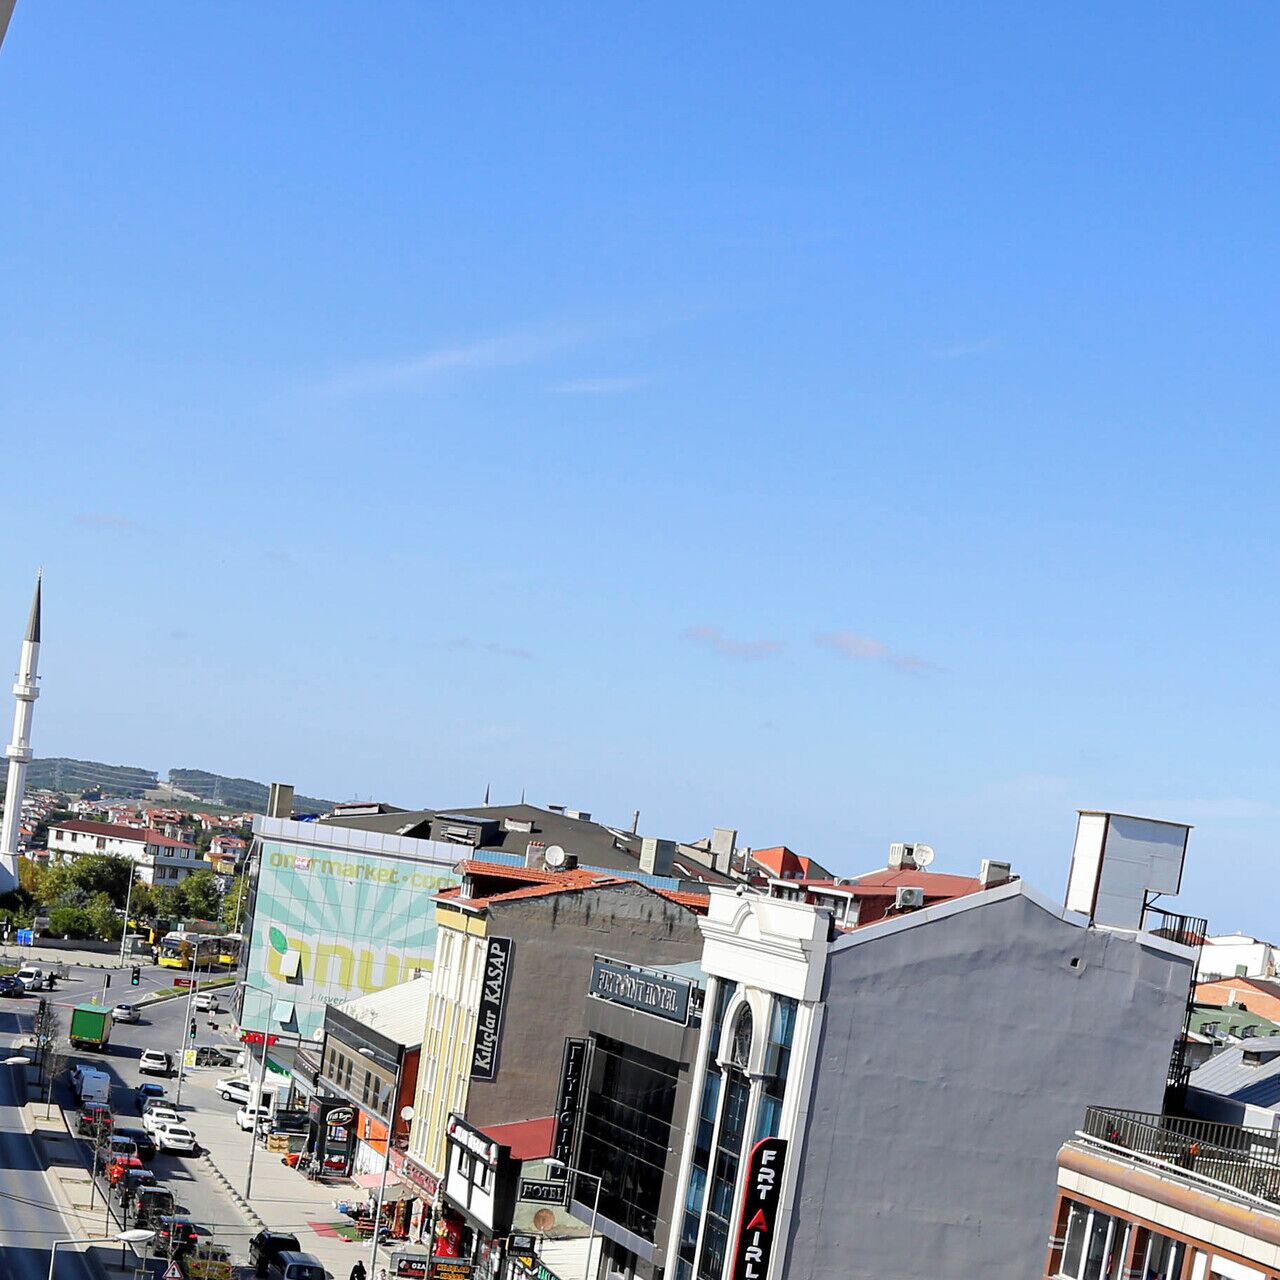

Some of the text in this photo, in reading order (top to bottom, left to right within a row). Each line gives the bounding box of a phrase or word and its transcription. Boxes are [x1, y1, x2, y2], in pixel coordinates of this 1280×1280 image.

[474, 943, 507, 1071] Kılıçlar KASAP
[645, 982, 678, 1012] HOTEL
[522, 1183, 563, 1200] HOTEL
[756, 1150, 777, 1200] FRT
